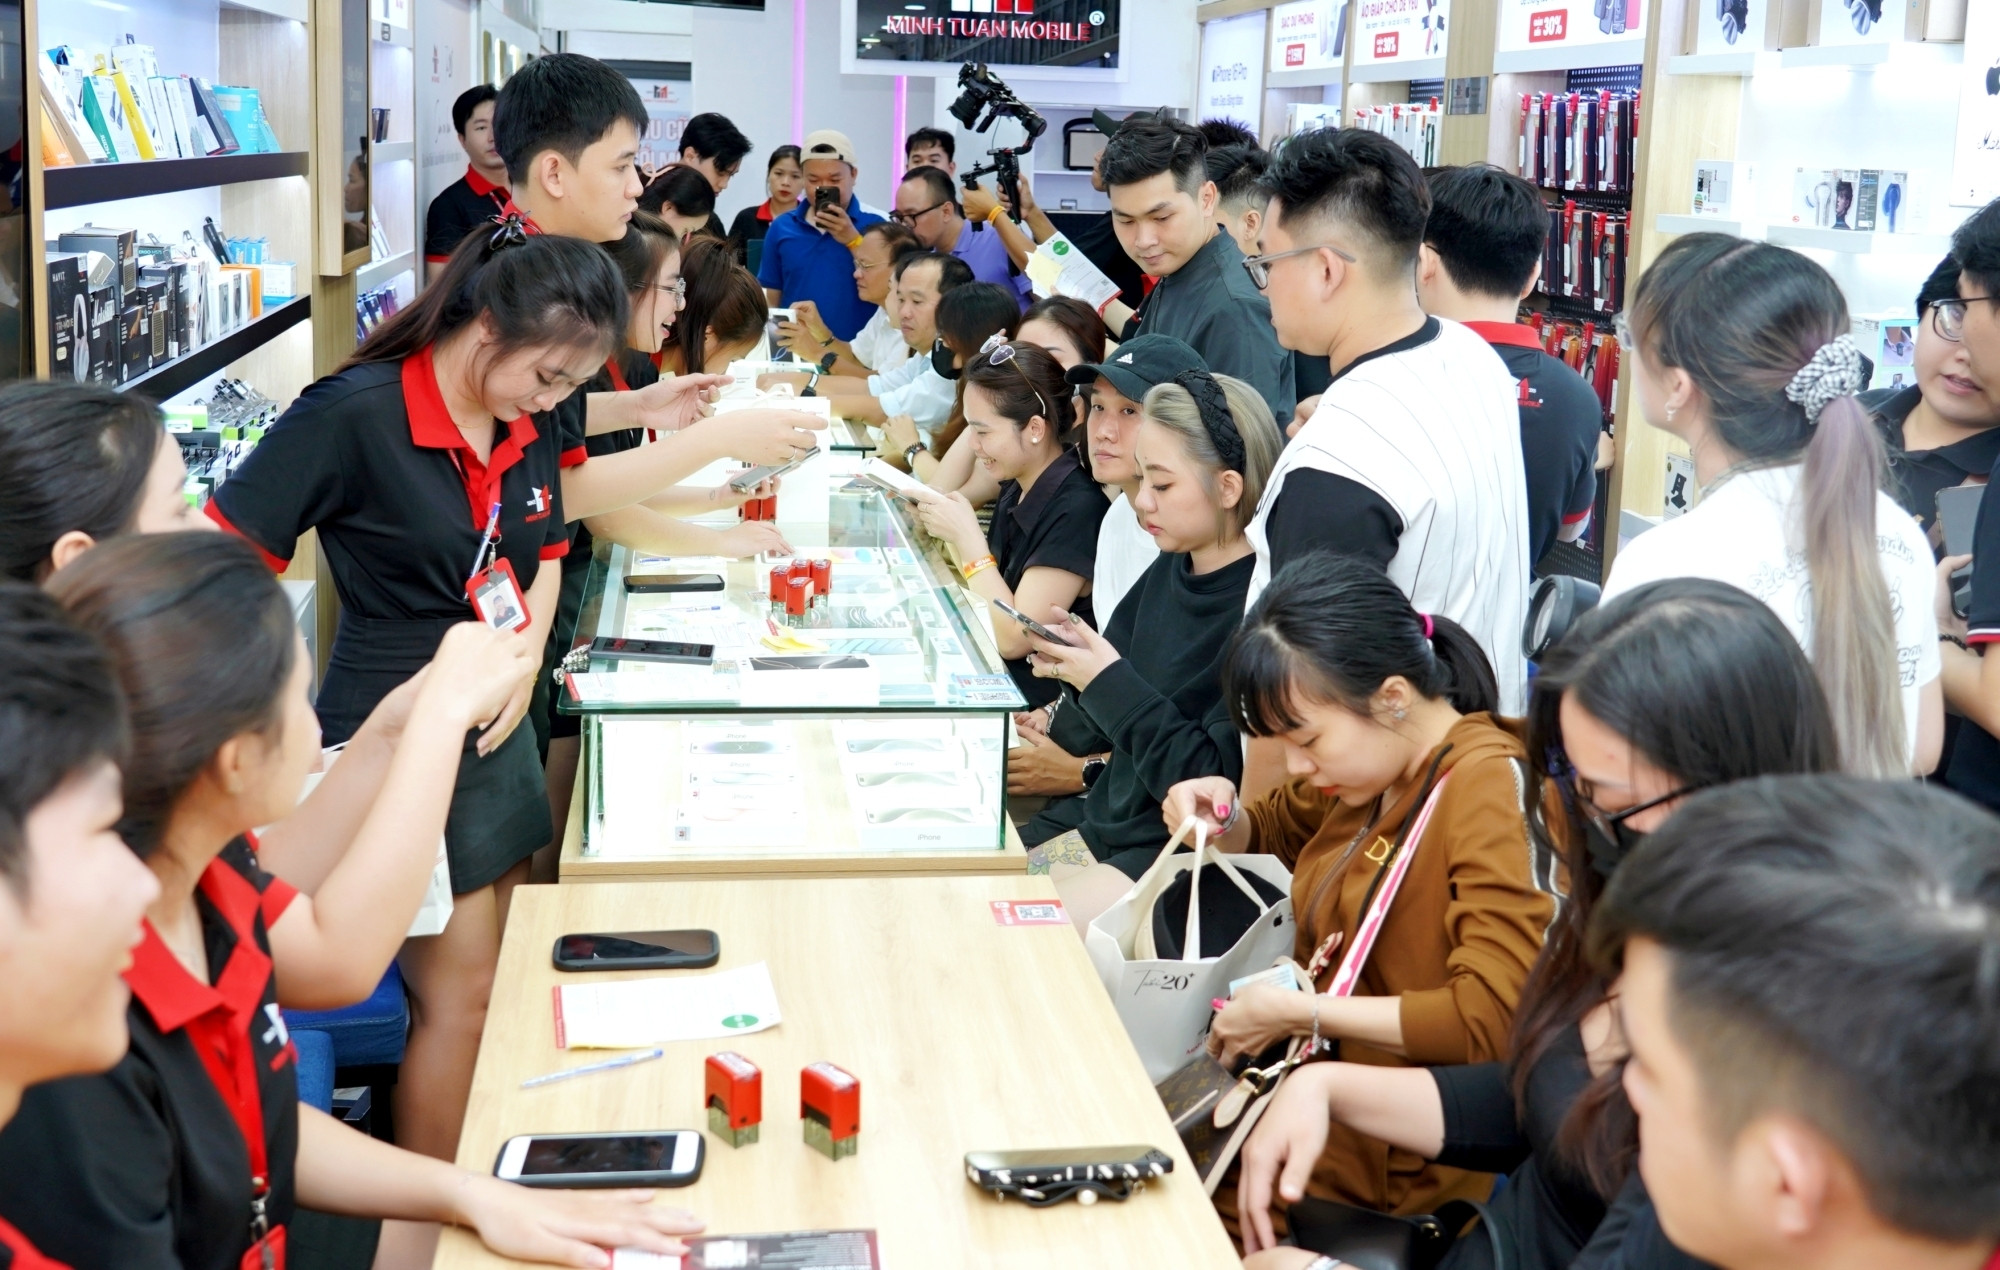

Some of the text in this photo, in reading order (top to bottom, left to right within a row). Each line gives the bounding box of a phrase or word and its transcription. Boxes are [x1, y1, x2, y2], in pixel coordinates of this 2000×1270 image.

[887, 15, 944, 35] MINH
[948, 17, 1007, 38] TUAN
[1011, 21, 1091, 41] MOBILE
[1543, 15, 1563, 37] 30%
[52, 271, 66, 283] HAVIT
[917, 833, 942, 841] iPhone
